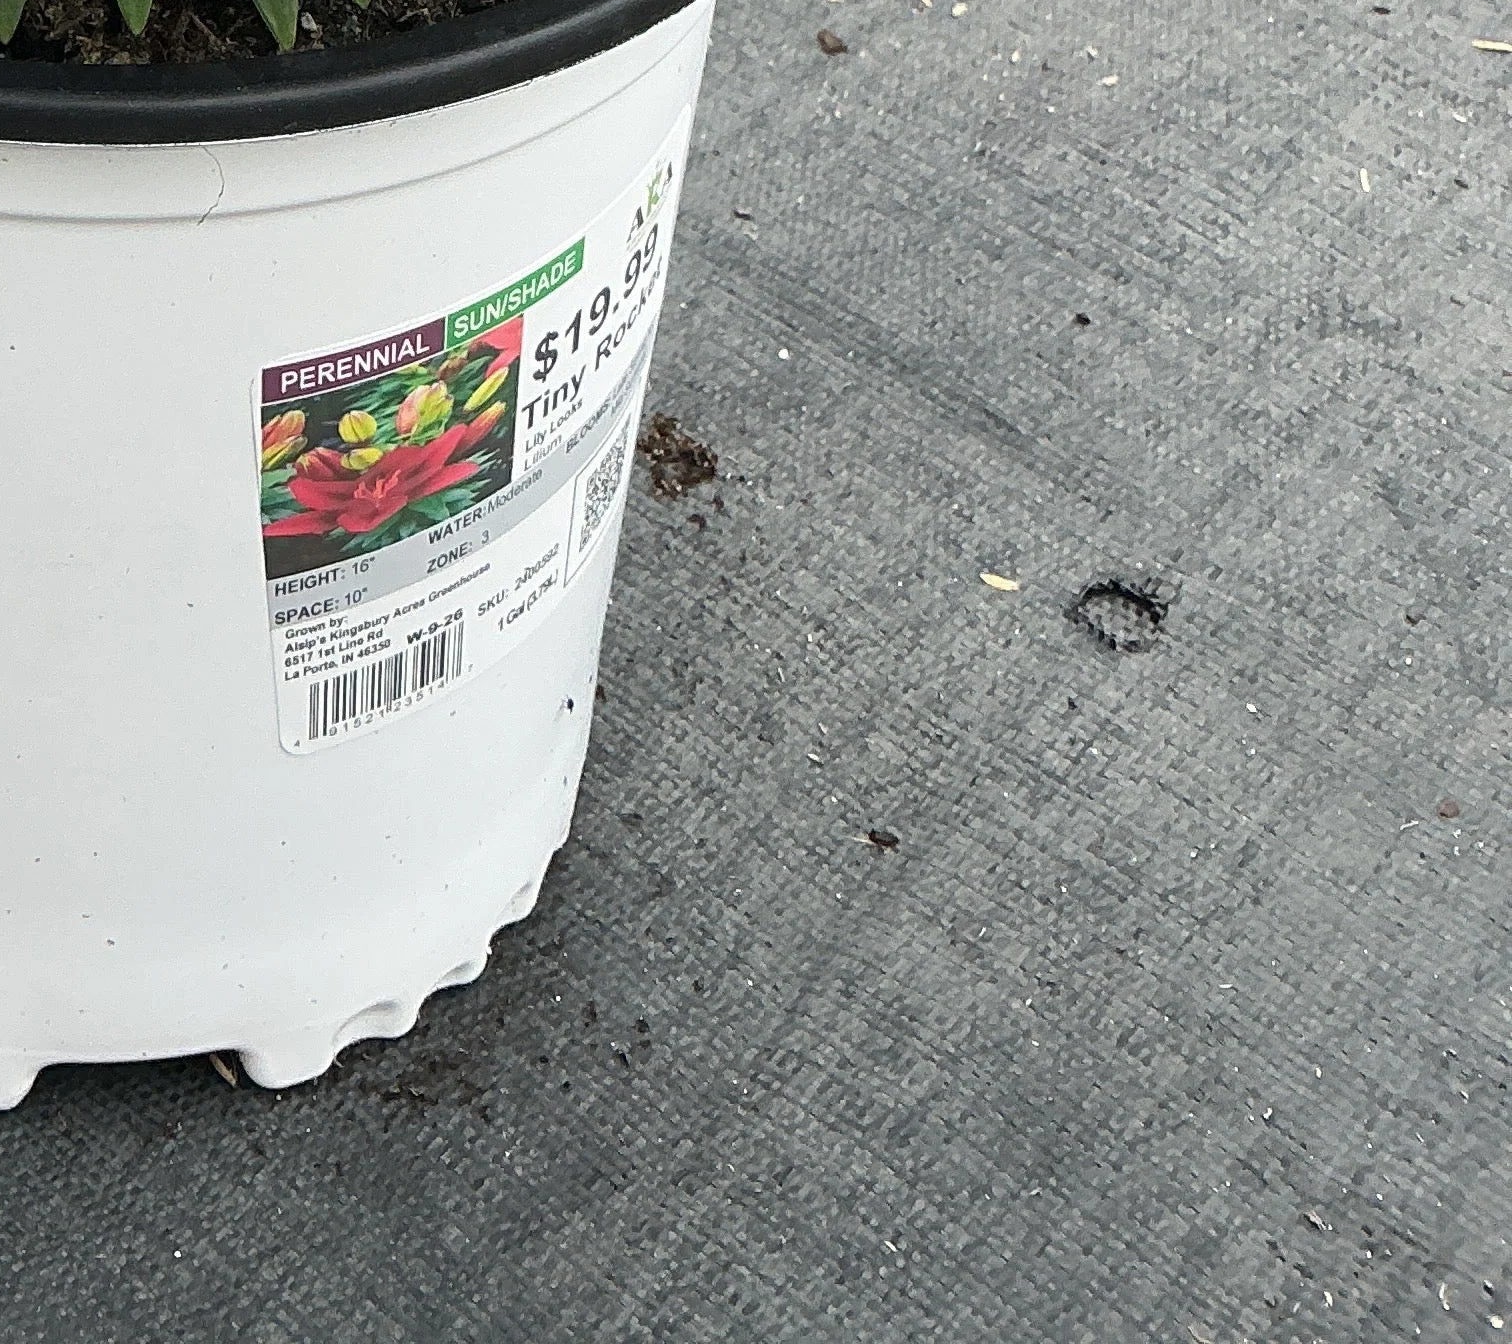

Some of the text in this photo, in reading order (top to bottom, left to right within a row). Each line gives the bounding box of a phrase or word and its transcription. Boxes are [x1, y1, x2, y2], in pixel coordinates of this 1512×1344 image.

[454, 250, 577, 338] SUN/SHADE
[533, 223, 659, 383] $19.99
[281, 333, 430, 394] PERENNIAL
[522, 363, 587, 430] Tiny
[524, 434, 562, 472] Lilium
[525, 398, 584, 453] Lily Looks
[428, 506, 487, 545] WATER:
[488, 468, 543, 514] Moderate
[274, 566, 346, 597] HEIGHT:
[351, 556, 376, 575] 16"
[426, 542, 473, 574] ZONE:
[274, 587, 368, 626] SPACE: 10"
[284, 562, 491, 654] Alsip's Kingsbury Acres Greenhouse
[477, 587, 510, 617] SKU:
[497, 616, 505, 632] 1
[506, 599, 525, 625] Gal
[284, 622, 326, 640] Grown
[317, 645, 336, 660] 1st
[338, 637, 364, 652] Line
[366, 628, 384, 643] Rd
[283, 669, 301, 682] La
[341, 653, 354, 665] IN
